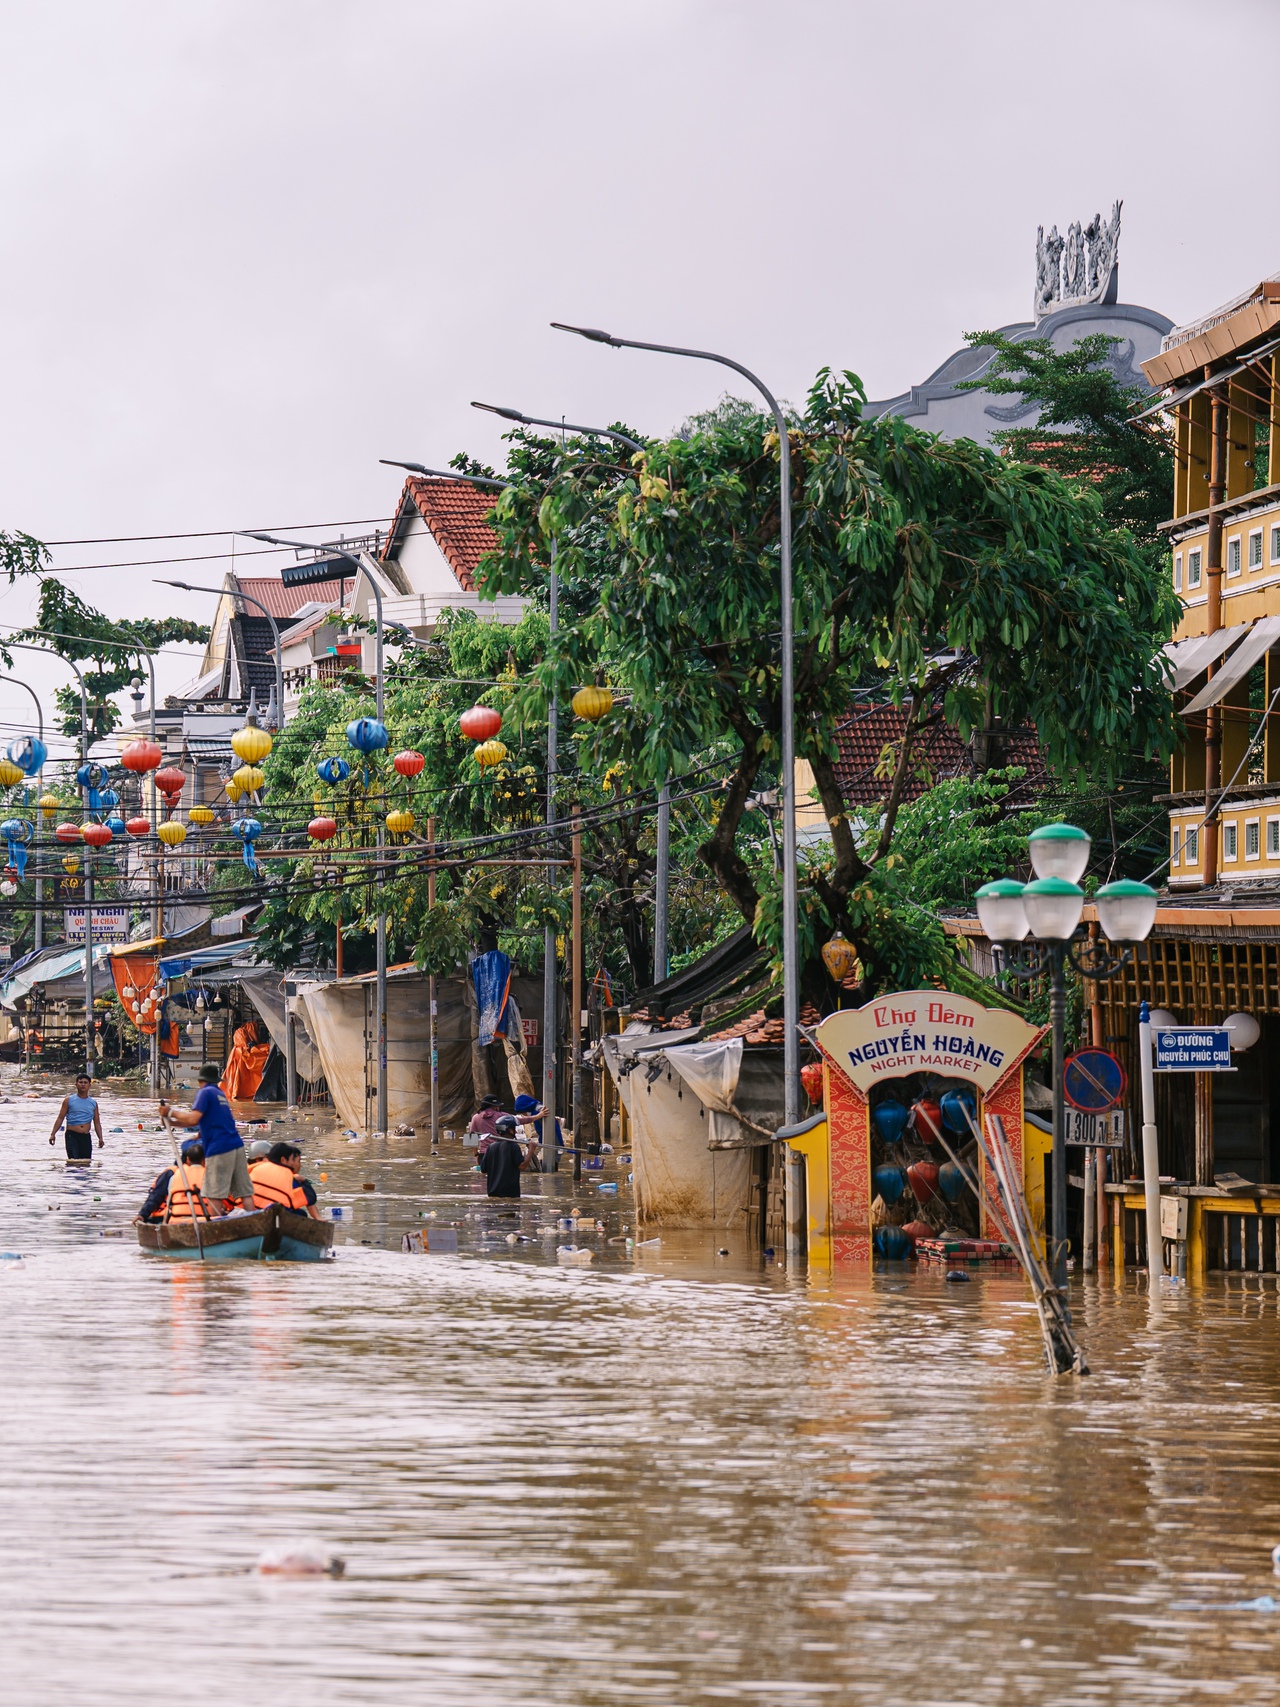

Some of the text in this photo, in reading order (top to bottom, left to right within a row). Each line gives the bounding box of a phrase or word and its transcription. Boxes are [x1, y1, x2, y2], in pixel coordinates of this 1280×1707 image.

[75, 918, 99, 926] QUNH
[874, 1002, 975, 1028] Chợ Đêm
[848, 1028, 1005, 1068] NGUYỄN HOÀNG
[1177, 1033, 1214, 1047] ĐƯỜNG
[870, 1054, 982, 1073] NIGHT MARKET
[1158, 1047, 1229, 1062] NGUYỄN PHÚC CHU
[1074, 1112, 1097, 1143] 300
